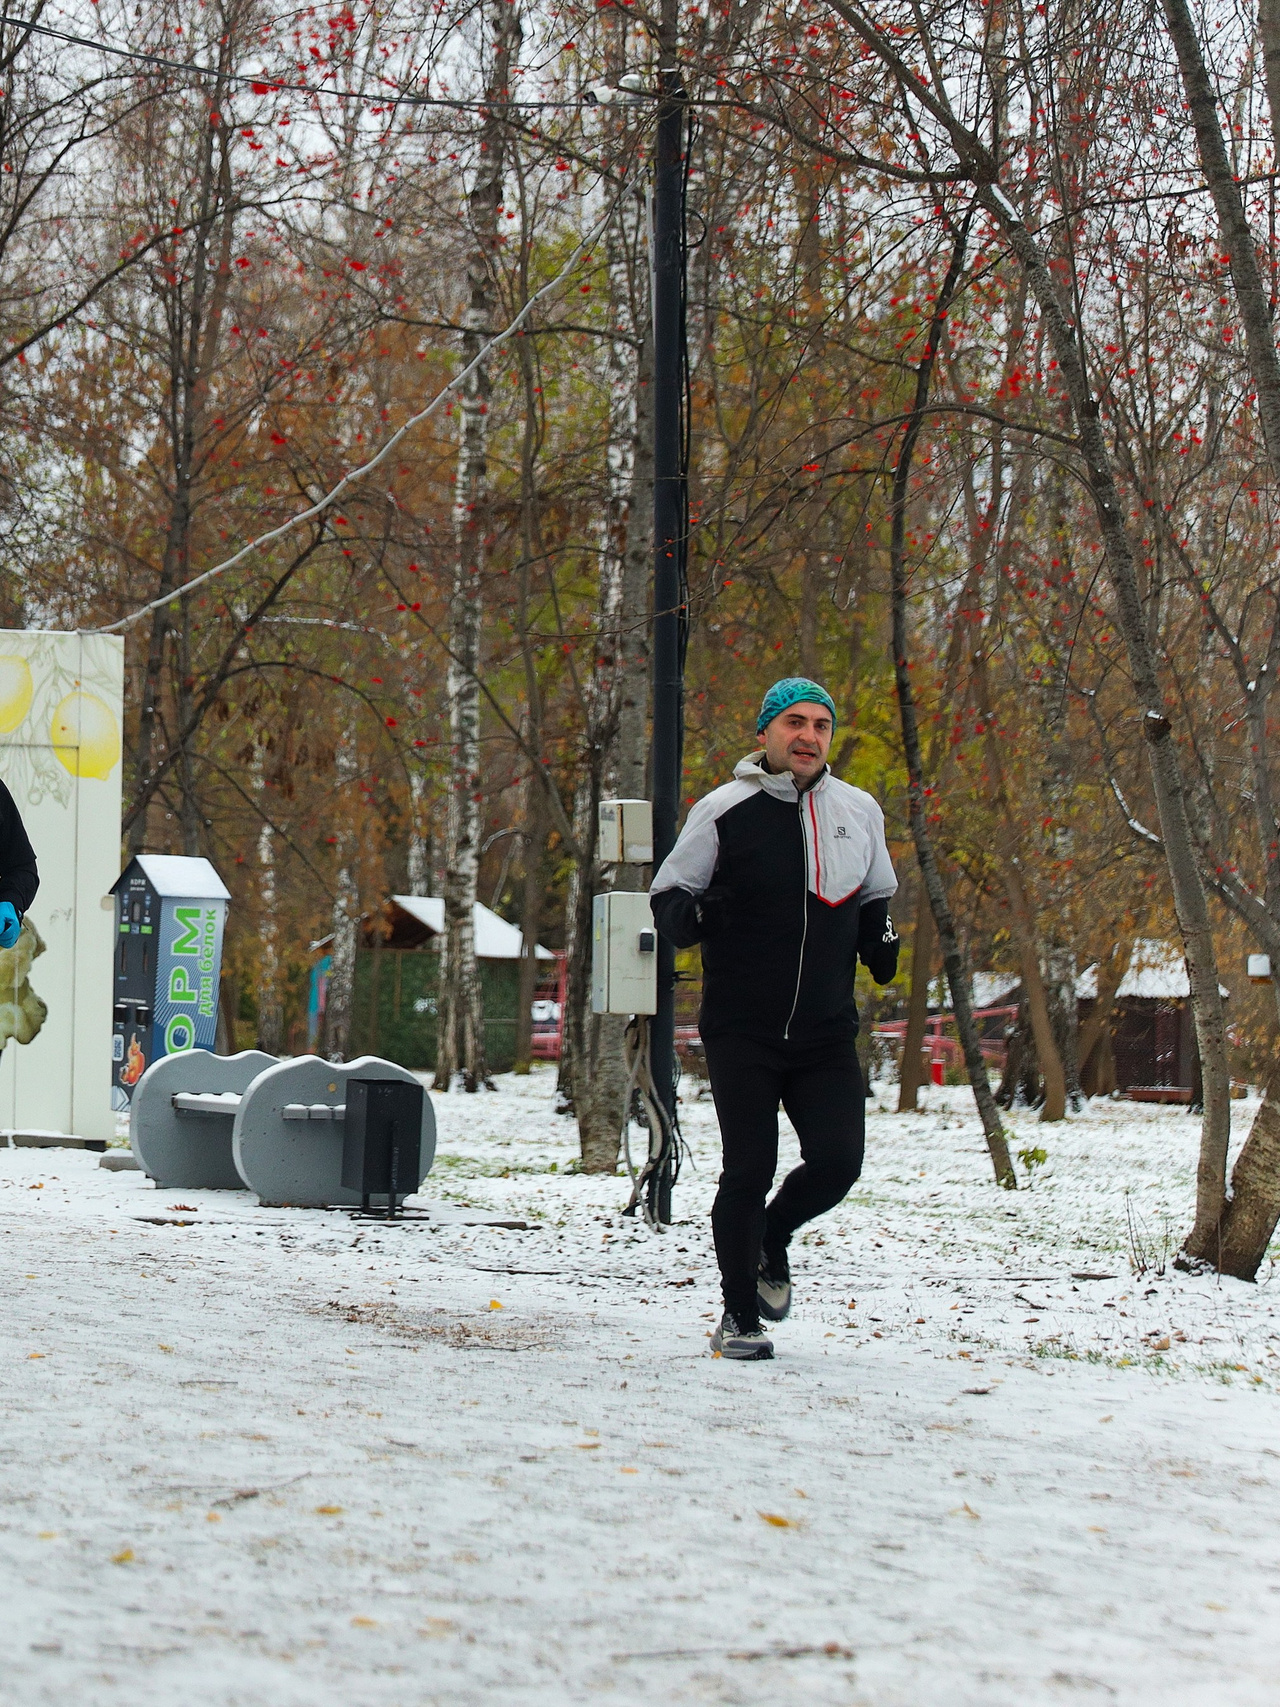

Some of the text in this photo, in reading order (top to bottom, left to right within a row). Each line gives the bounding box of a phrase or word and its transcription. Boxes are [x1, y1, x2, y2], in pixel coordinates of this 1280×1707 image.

[166, 907, 202, 1053] ОРМ
[198, 908, 217, 1017] для белок
